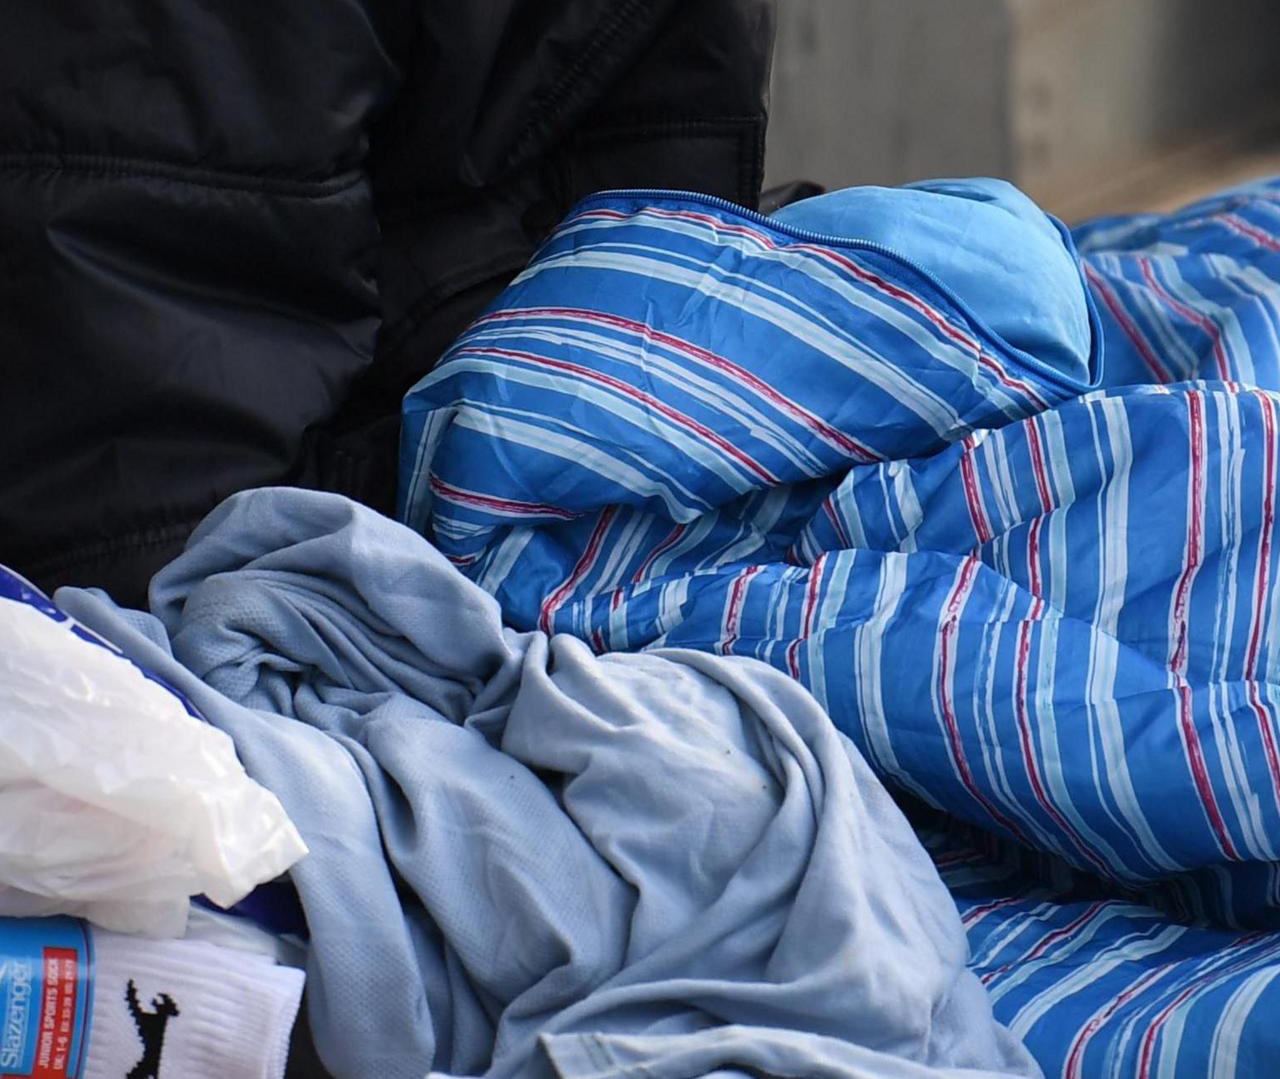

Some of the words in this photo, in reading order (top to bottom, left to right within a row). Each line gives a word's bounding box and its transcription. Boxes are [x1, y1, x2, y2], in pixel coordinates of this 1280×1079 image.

[46, 958, 59, 986] SOCK
[0, 960, 31, 1068] Slazenger
[43, 987, 58, 1029] SPORTS
[39, 1032, 54, 1069] JUNIOR
